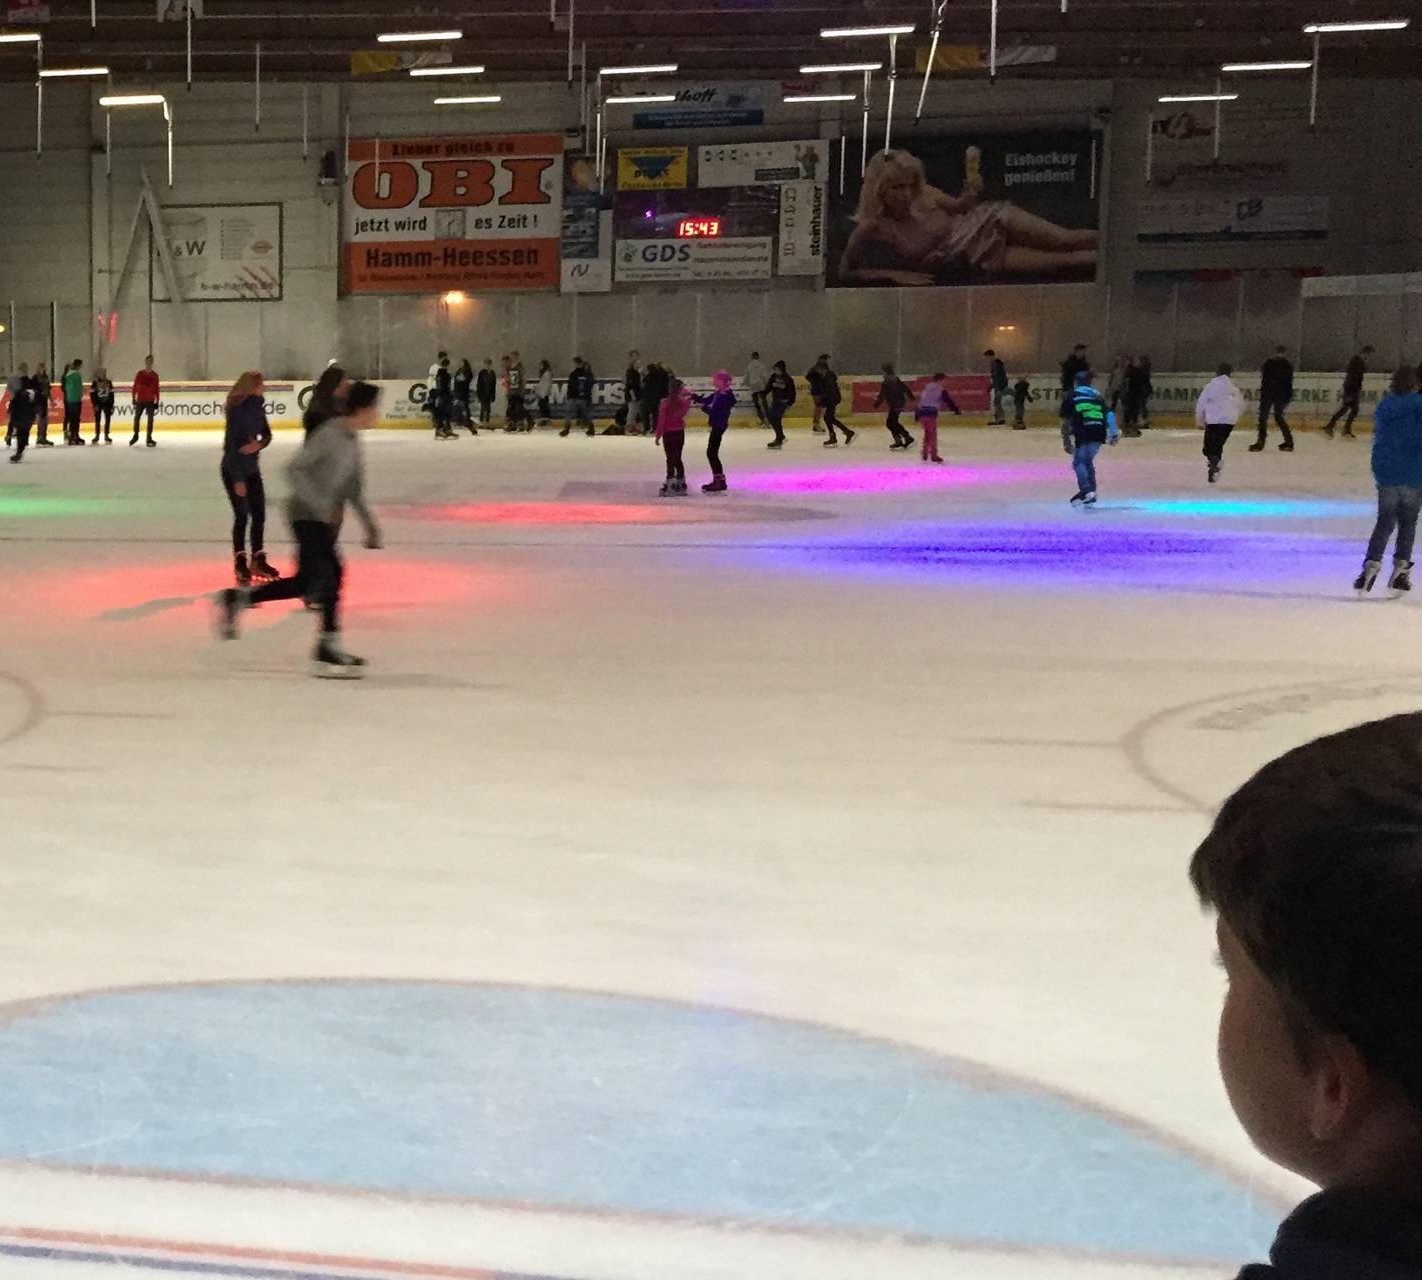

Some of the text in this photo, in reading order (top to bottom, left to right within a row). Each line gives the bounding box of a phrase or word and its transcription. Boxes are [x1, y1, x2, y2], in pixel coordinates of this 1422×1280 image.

[392, 141, 515, 157] Lieber gleich zu
[1005, 151, 1078, 166] Eishockey
[352, 158, 555, 210] OBI
[353, 217, 390, 235] jetzt
[394, 216, 427, 231] wird
[474, 217, 493, 229] es
[497, 214, 528, 229] Zeit
[678, 220, 720, 237] 15:43
[809, 185, 824, 257] steinhauer
[365, 246, 539, 268] Hamm-Heessen
[641, 243, 692, 263] GDS
